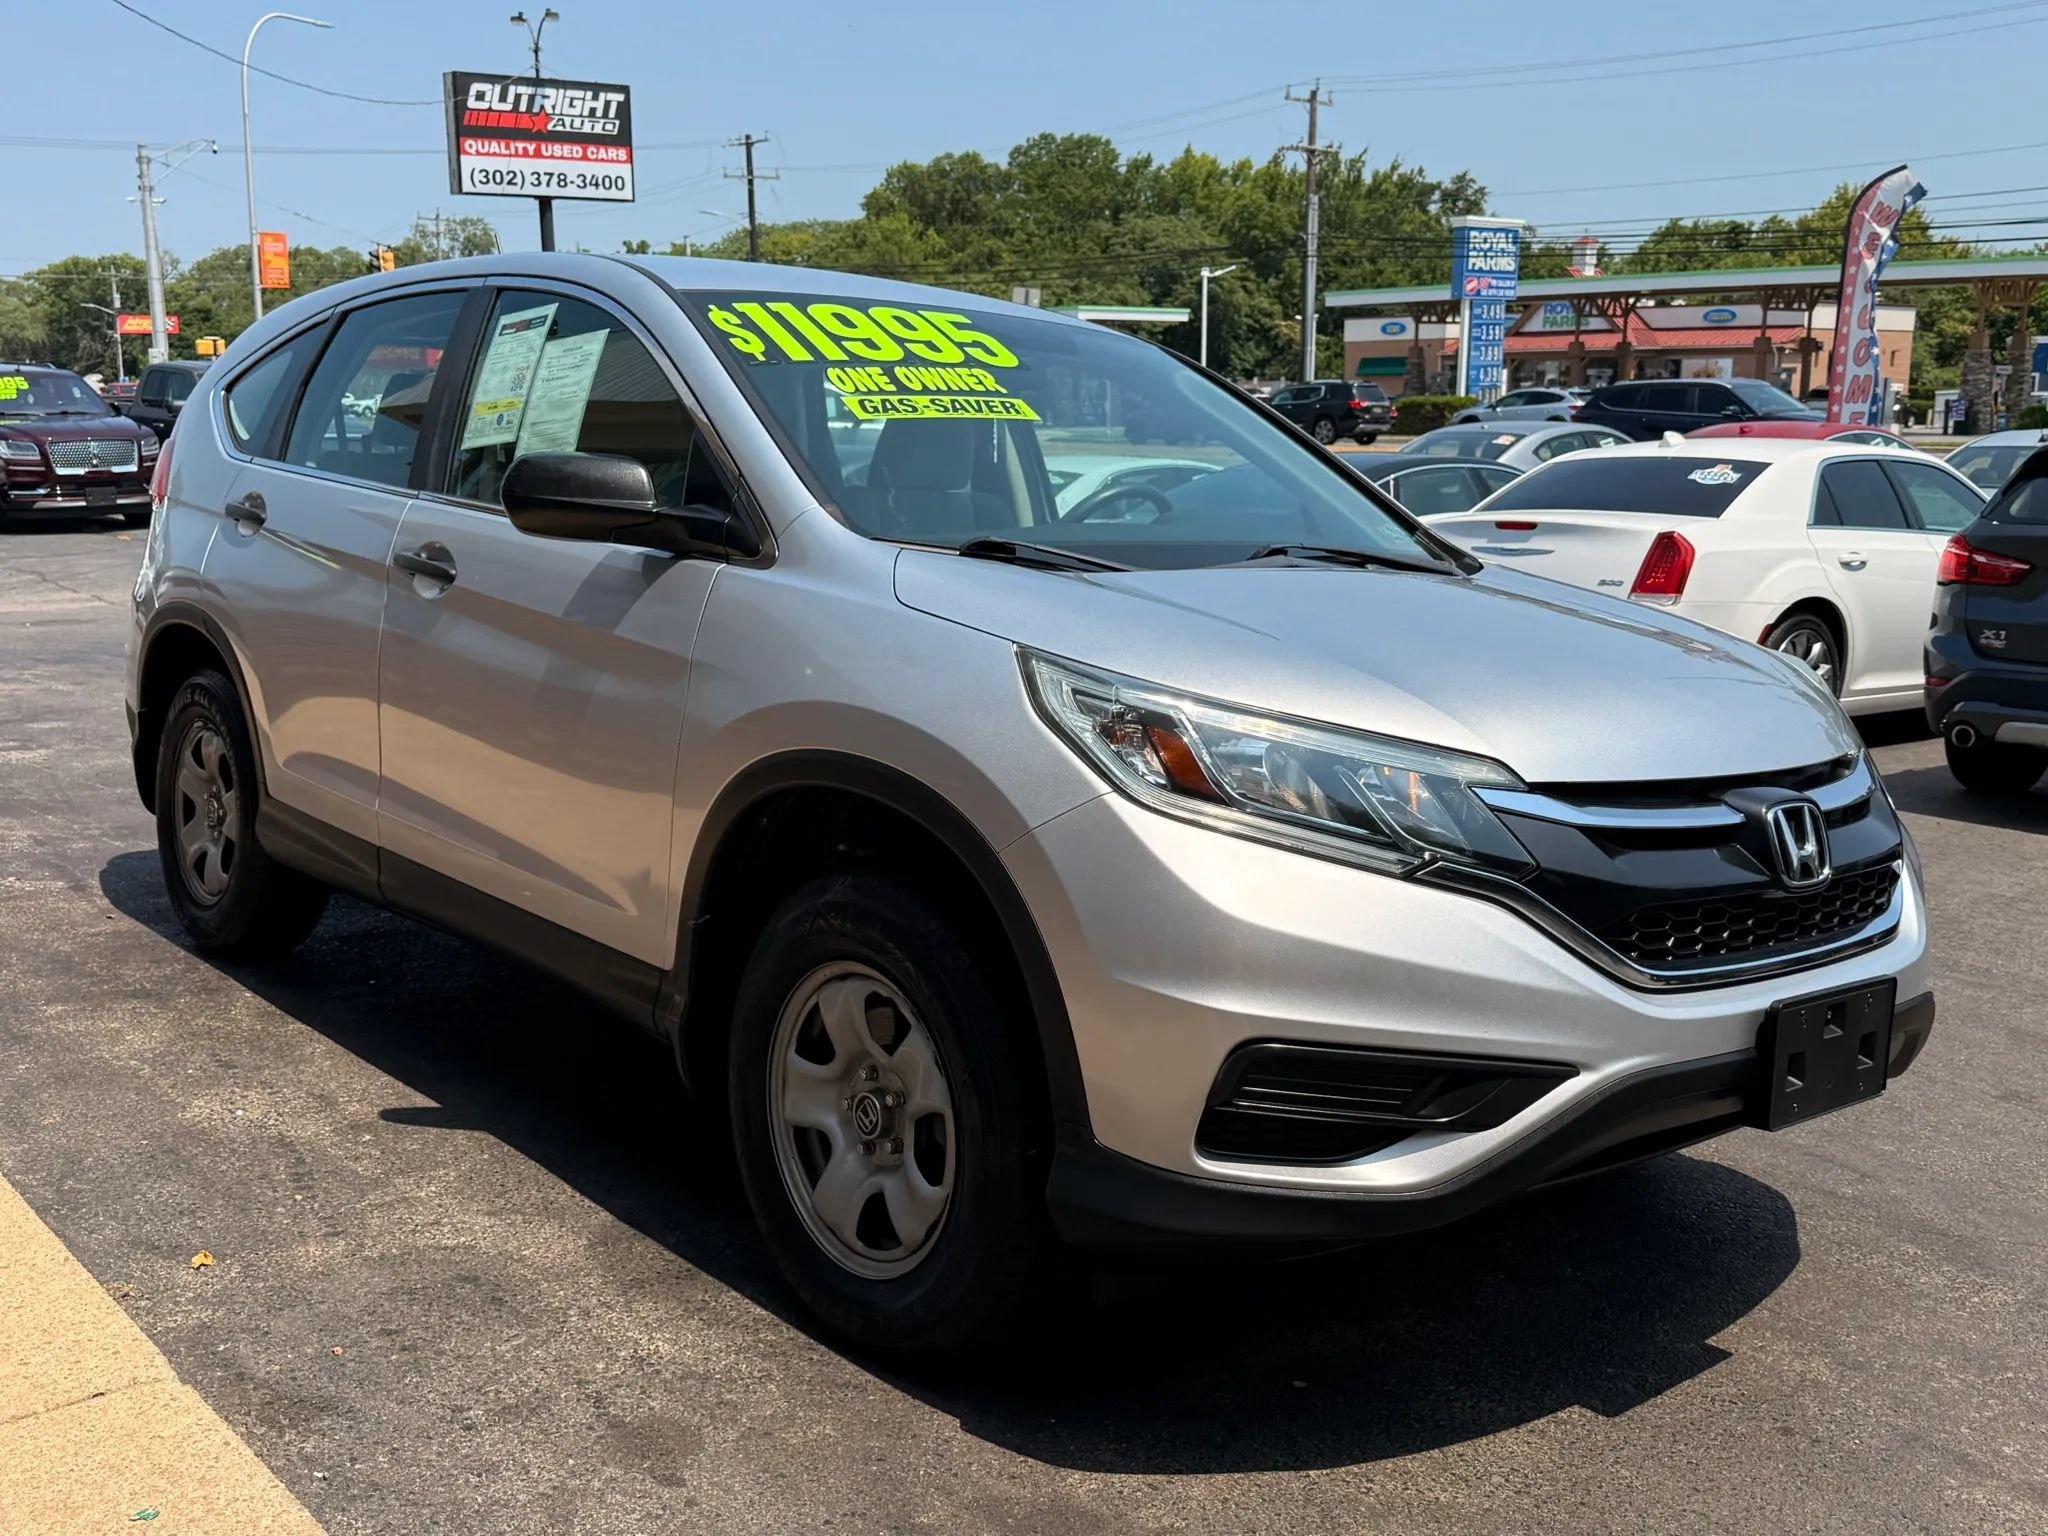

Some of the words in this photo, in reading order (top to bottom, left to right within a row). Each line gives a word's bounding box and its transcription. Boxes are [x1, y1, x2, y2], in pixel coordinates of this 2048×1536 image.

[466, 82, 625, 118] OUTRIGHT
[551, 117, 618, 133] AUTO
[464, 139, 536, 156] QUALITY
[541, 143, 582, 158] USED
[587, 147, 628, 161] CARS
[470, 167, 525, 190] (302)
[530, 171, 625, 191] 378-3400
[1469, 230, 1516, 251] ROYAL
[1468, 251, 1515, 271] FARMS
[708, 302, 1019, 368] $11995
[826, 366, 897, 394] ONE
[894, 366, 1008, 394] OWNER
[858, 398, 1021, 416] GAS-SAVER
[1979, 629, 2007, 640] X1
